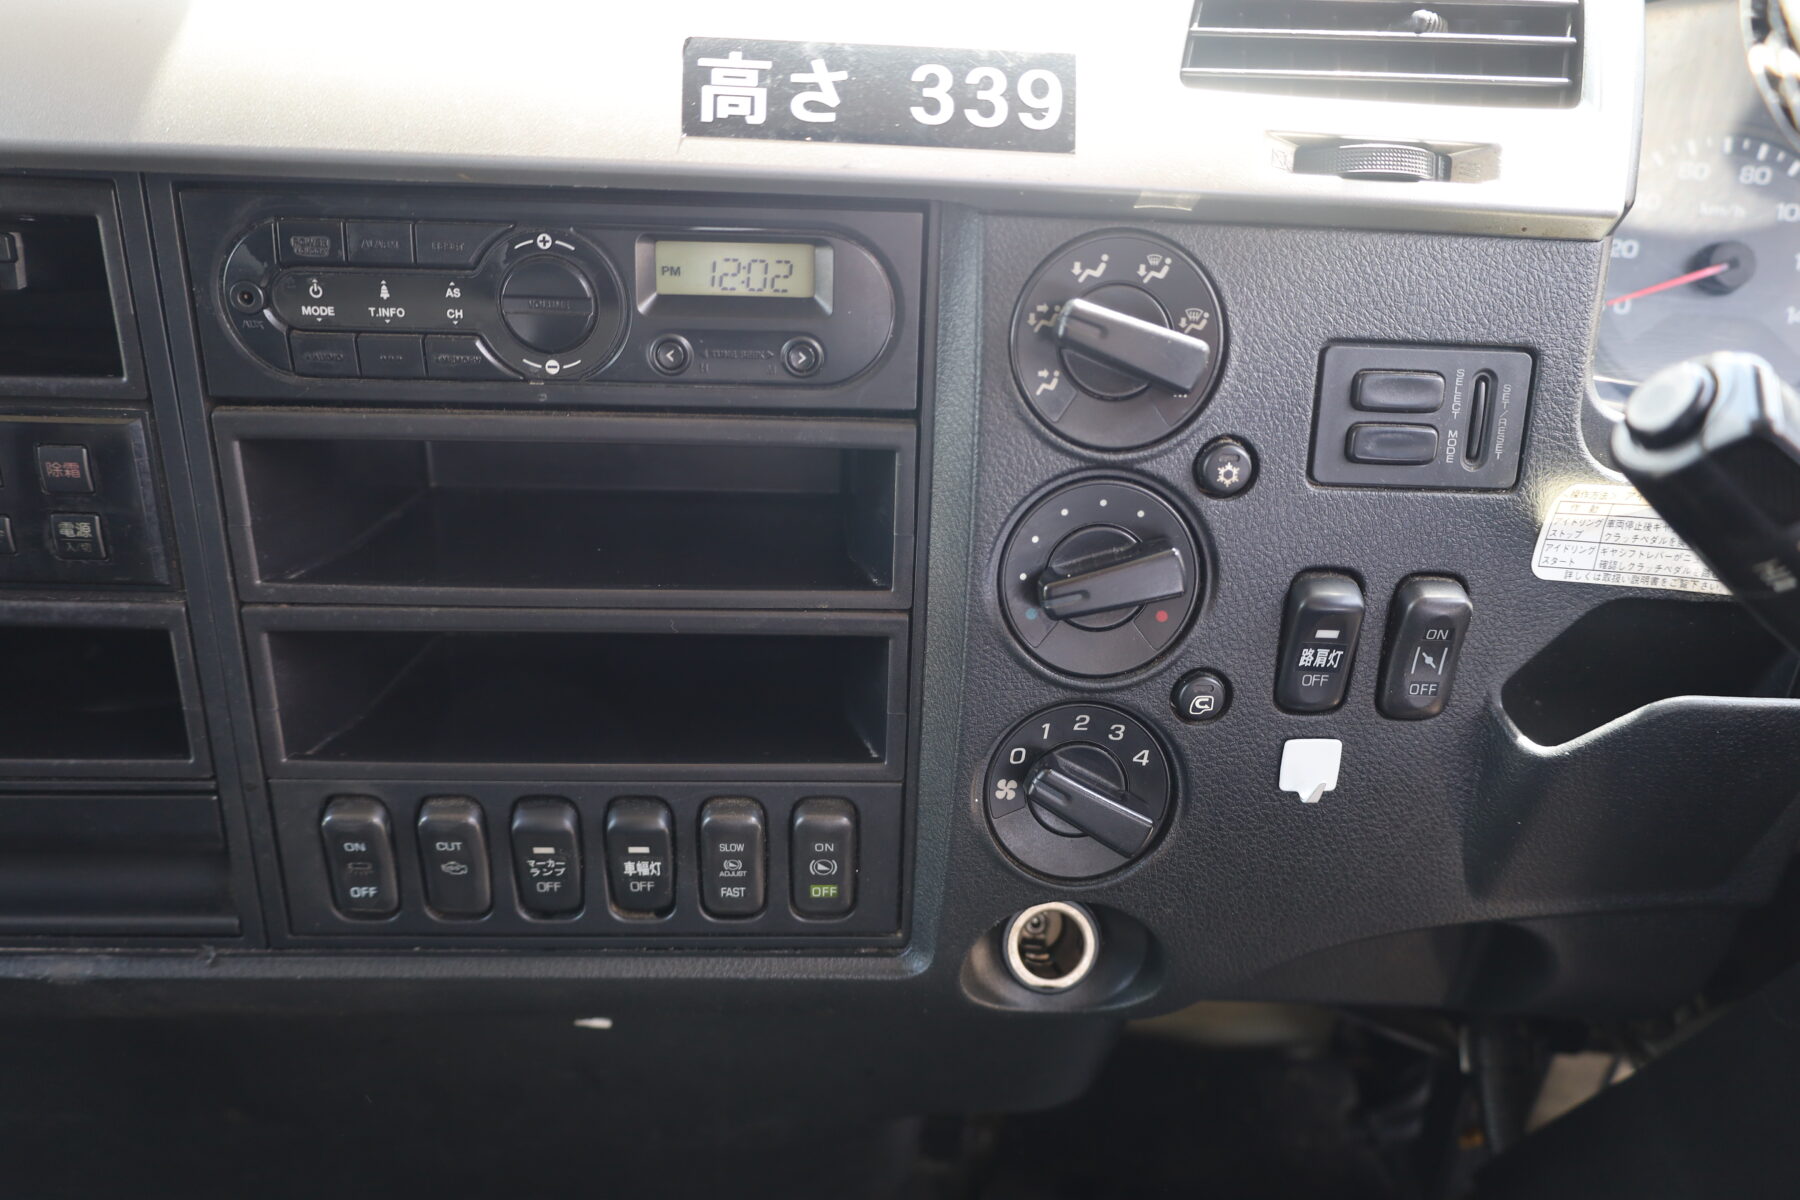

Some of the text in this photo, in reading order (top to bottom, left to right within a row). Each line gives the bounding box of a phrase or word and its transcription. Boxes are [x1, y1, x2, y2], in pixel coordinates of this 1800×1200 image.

[697, 51, 1063, 130] 高さ 339
[1740, 166, 1772, 185] 80
[661, 258, 793, 293] PM 12:02
[445, 288, 461, 298] AS
[301, 306, 336, 317] MODE
[368, 307, 405, 318] T.INFO
[446, 308, 463, 319] CH
[1452, 369, 1465, 420] SELECT
[1446, 429, 1458, 464] MODE
[1544, 543, 1596, 555] アイドリング
[1542, 556, 1575, 567] スタート
[1426, 629, 1448, 640] ON
[1298, 648, 1344, 669] 路肩灯
[1301, 674, 1330, 687] OFF
[1409, 683, 1438, 695] OFF
[1072, 714, 1090, 731] 2
[1041, 723, 1051, 740] 1
[1107, 724, 1125, 741] 3
[1009, 747, 1026, 765] 0
[1132, 749, 1150, 766] 4
[343, 842, 367, 852] ON
[436, 842, 463, 851] CUT
[719, 843, 744, 853] SLOW
[814, 843, 834, 852] ON
[526, 859, 566, 869] マーカー
[623, 860, 662, 877] 車幅灯
[529, 867, 567, 877] ランプ
[349, 886, 378, 898] OFF
[536, 881, 562, 892] OFF
[629, 881, 655, 892] OFF
[811, 886, 837, 897] OFF
[720, 887, 746, 898] FAST
